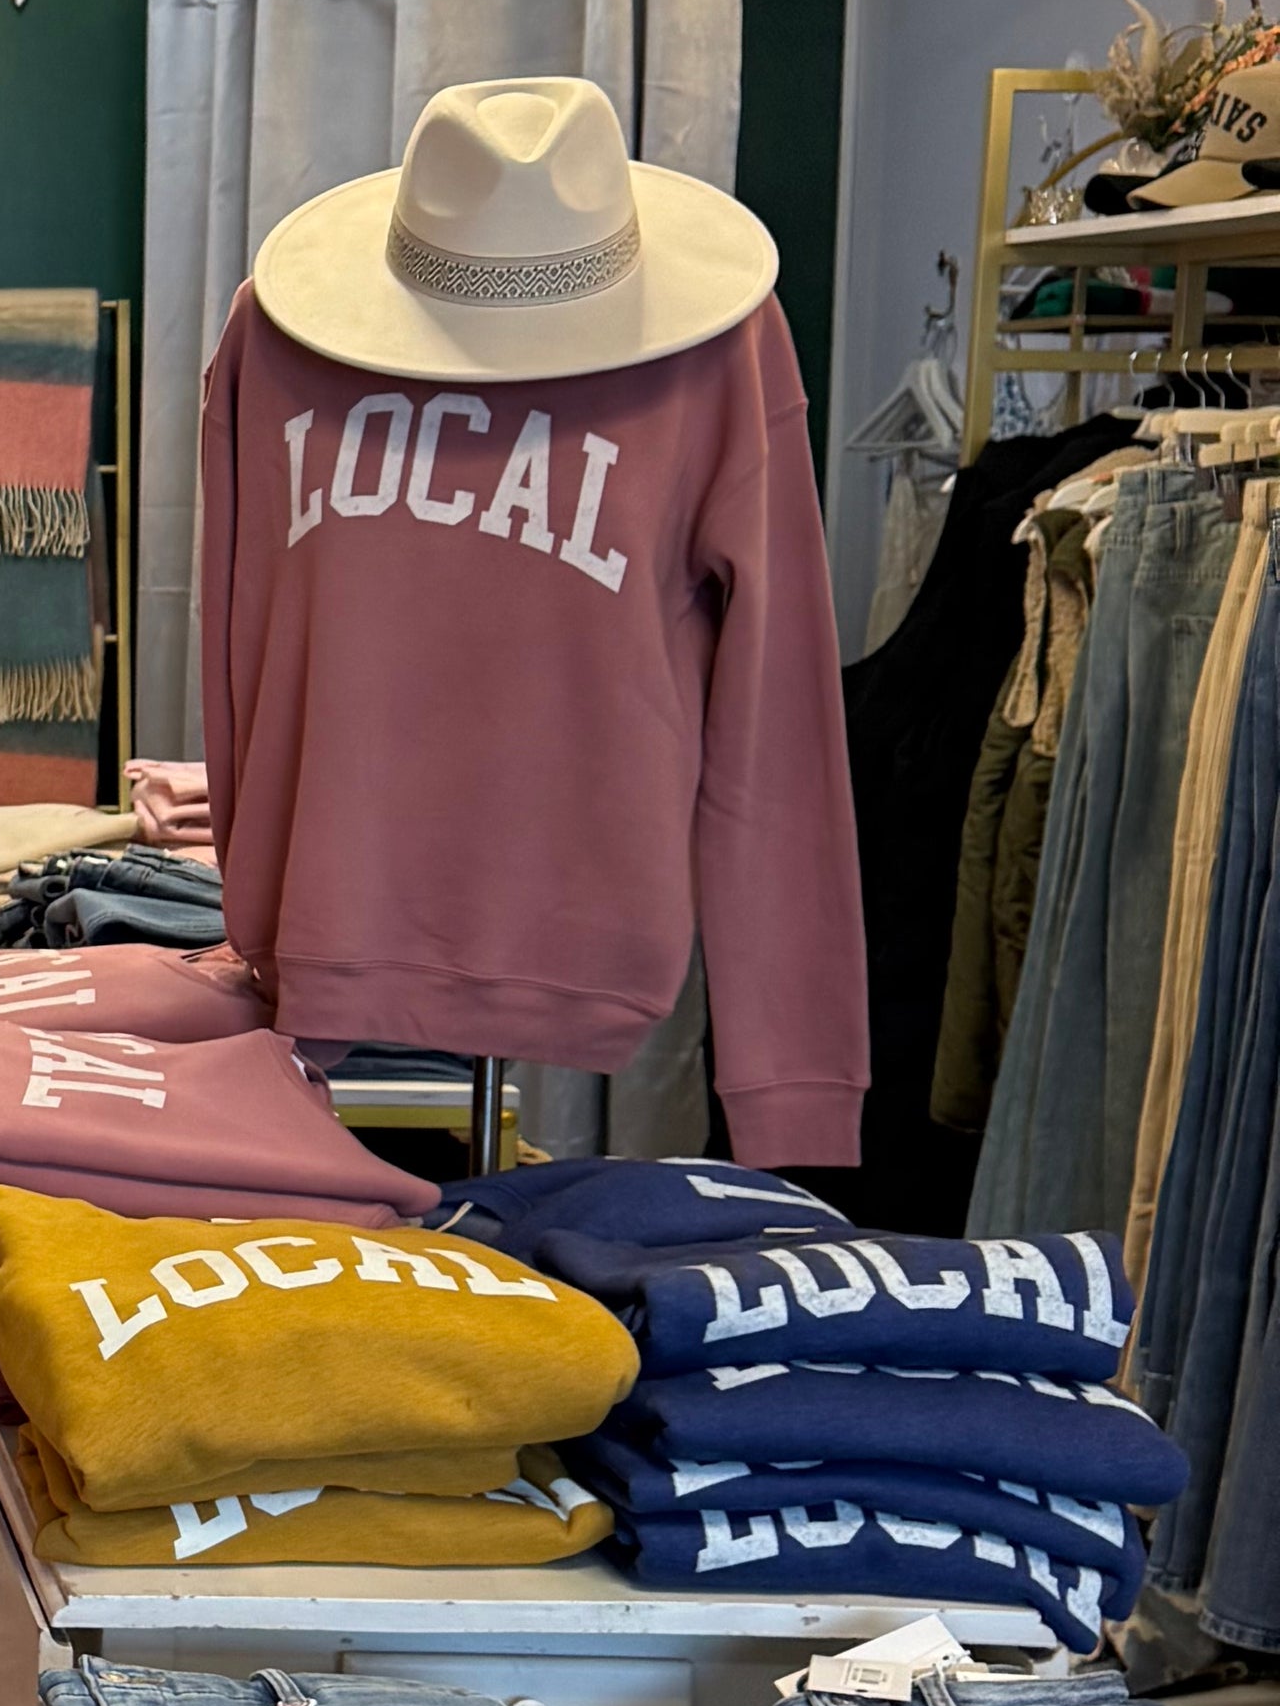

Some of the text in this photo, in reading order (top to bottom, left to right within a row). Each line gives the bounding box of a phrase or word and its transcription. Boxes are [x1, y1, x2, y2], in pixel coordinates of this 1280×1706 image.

[283, 391, 629, 595] LOCAL
[68, 1234, 559, 1361] LOCAL
[678, 1230, 1133, 1348] LOCAL
